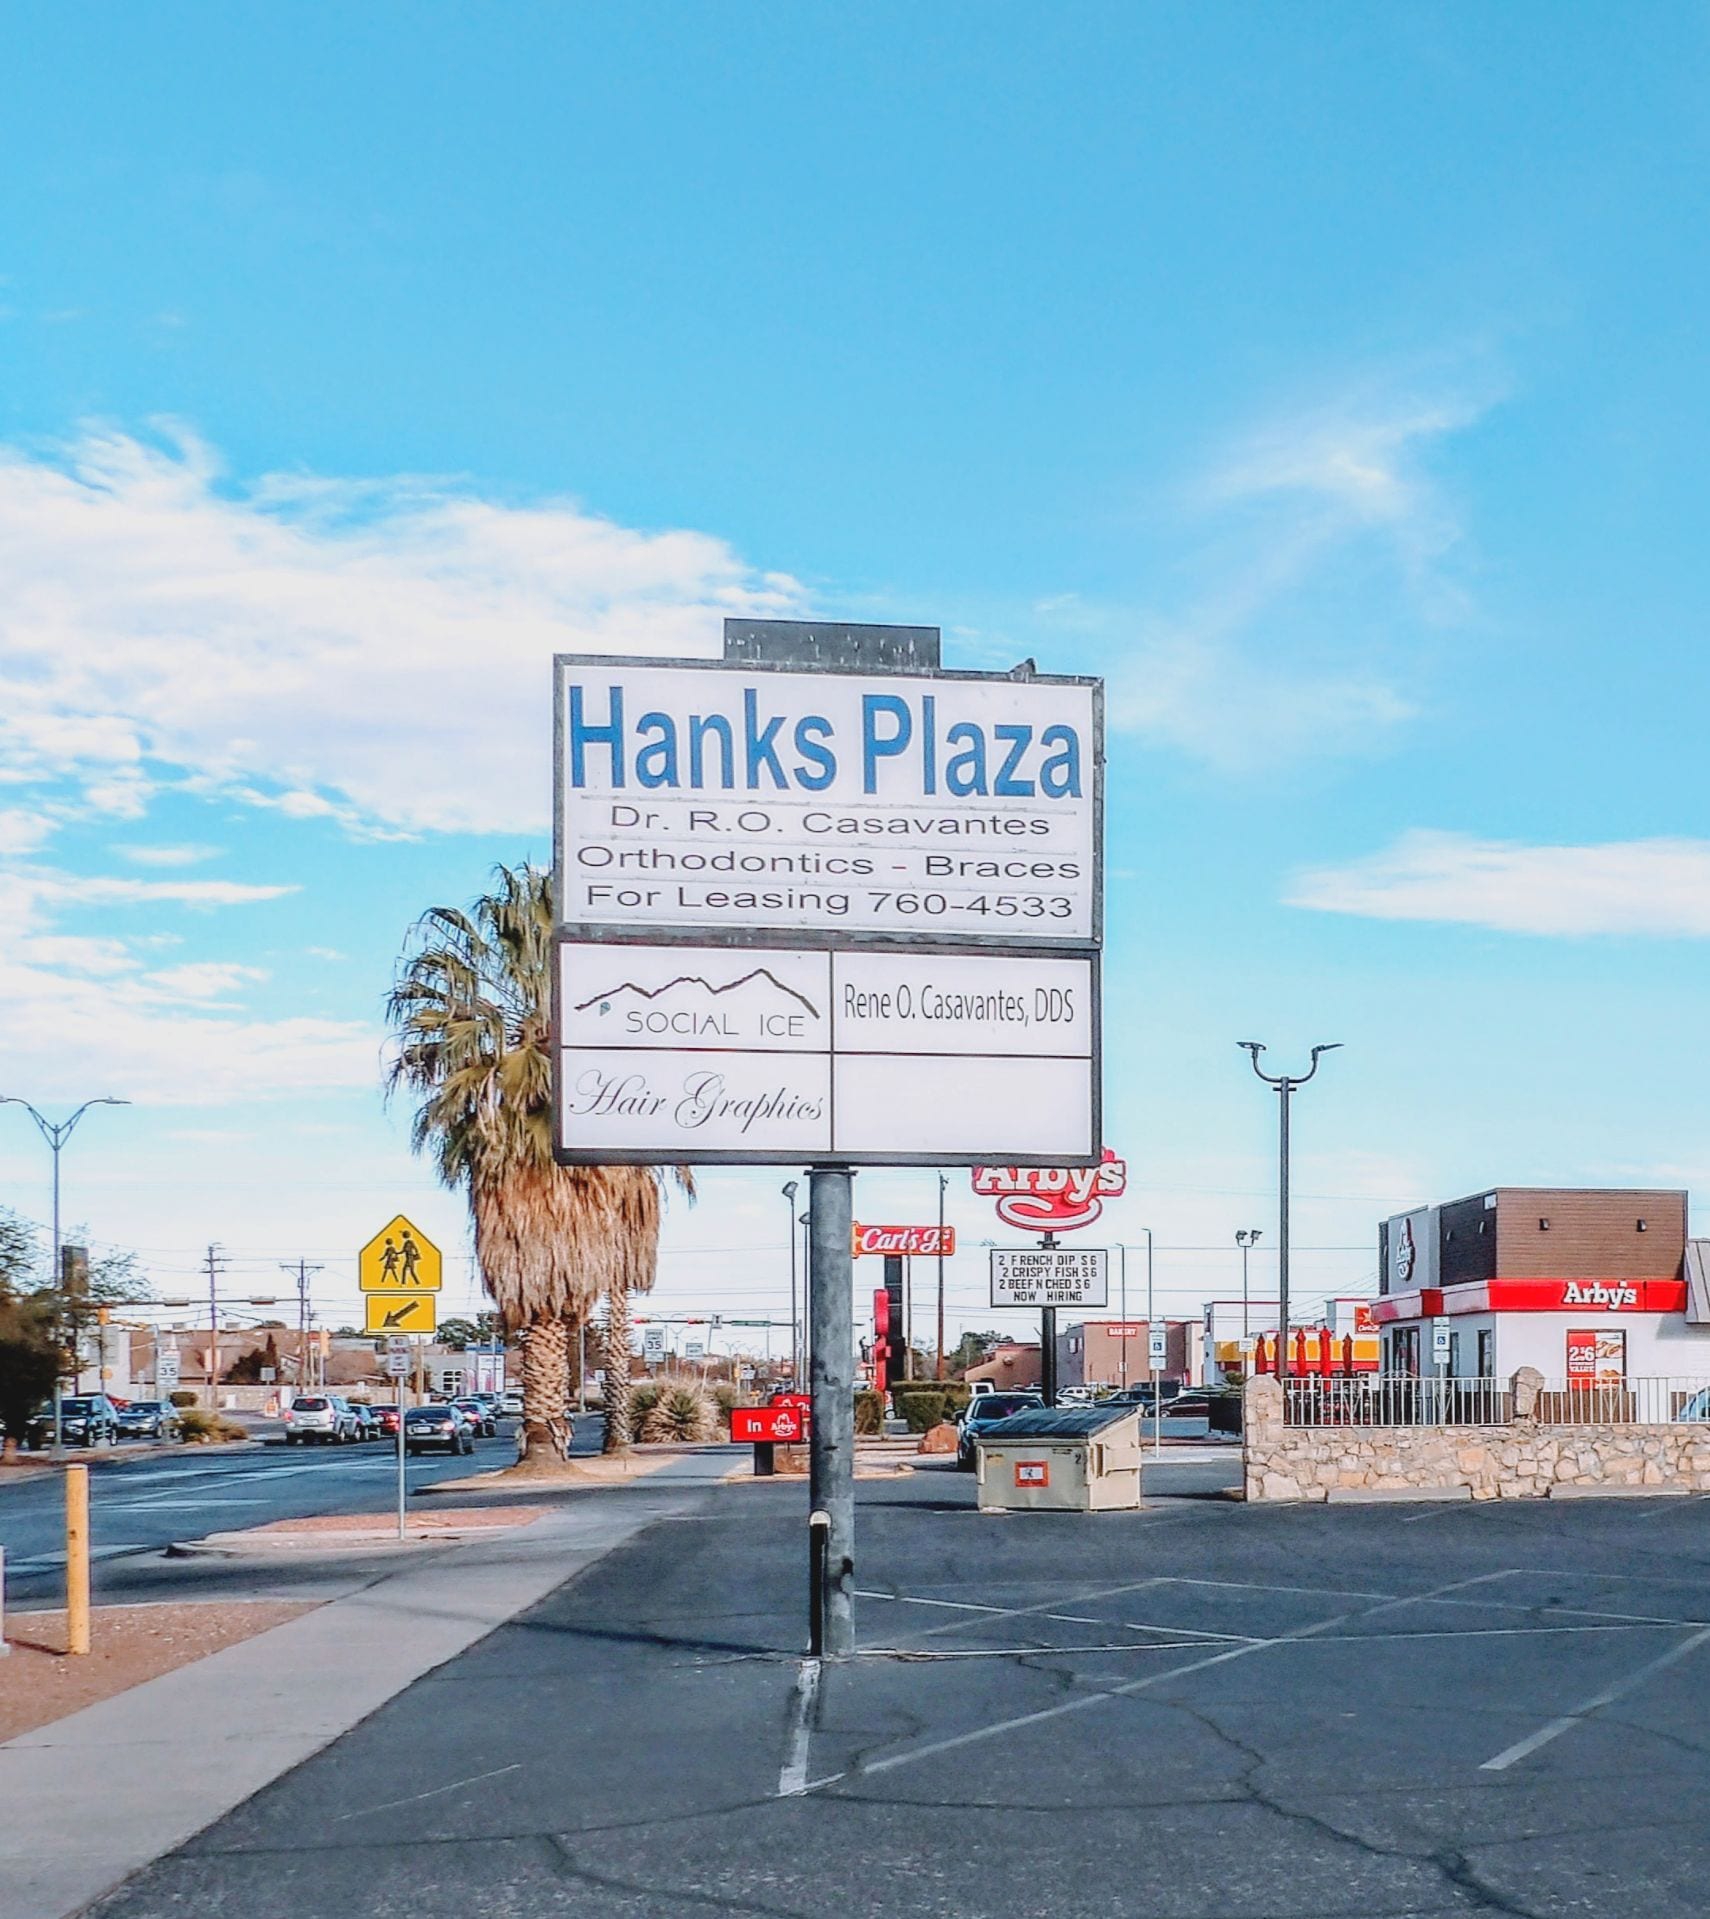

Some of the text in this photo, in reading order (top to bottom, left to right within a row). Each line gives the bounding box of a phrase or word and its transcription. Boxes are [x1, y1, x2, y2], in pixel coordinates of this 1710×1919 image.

[569, 685, 1082, 799] Hanks Plaza
[611, 805, 1050, 836] Dr. R.O. Casavantes
[577, 846, 874, 876] Orthodontics
[925, 856, 1081, 880] Braces
[587, 885, 1073, 918] For Leasing 760-4533
[845, 983, 1074, 1028] Rene O. Casavantes, DDS
[625, 1010, 805, 1038] SOCIAL ICE
[569, 1069, 824, 1134] Hair Graphics
[976, 1162, 1124, 1202] Arbys
[861, 1227, 919, 1252] Carl's
[998, 1255, 1005, 1266] 2
[1057, 1255, 1075, 1266] DIP
[1090, 1255, 1097, 1266] 6
[1002, 1267, 1009, 1278] 2
[1012, 1267, 1051, 1278] CRISPY
[1055, 1267, 1079, 1278] FISH
[1090, 1267, 1097, 1278] 6
[999, 1279, 1006, 1290] 2
[1008, 1279, 1033, 1290] BEEF
[1036, 1279, 1043, 1290] N
[1045, 1279, 1072, 1290] CHED
[1084, 1279, 1091, 1290] 6
[1013, 1291, 1083, 1302] NOW HIRING
[1563, 1281, 1637, 1310] Arby's
[647, 1340, 662, 1350] 35
[160, 1367, 177, 1377] 35
[747, 1418, 762, 1433] In
